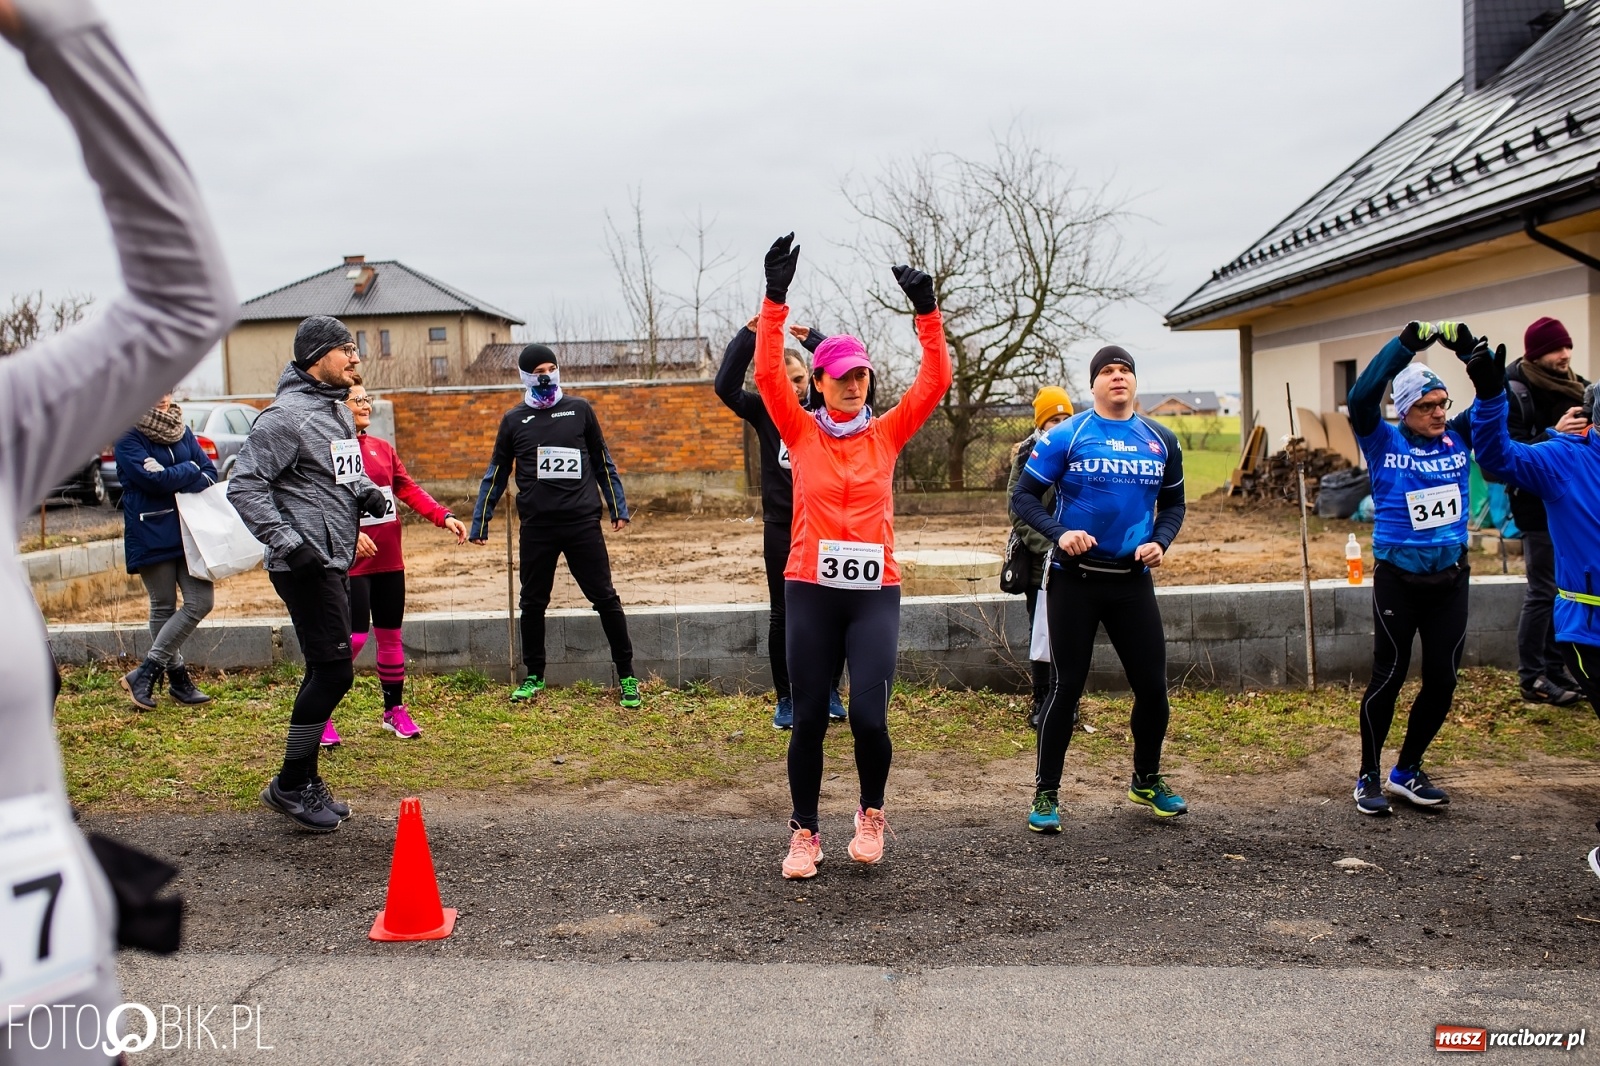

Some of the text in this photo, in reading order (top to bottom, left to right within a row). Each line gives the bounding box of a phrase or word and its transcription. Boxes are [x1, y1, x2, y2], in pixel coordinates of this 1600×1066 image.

[336, 454, 361, 475] 218
[540, 458, 578, 472] 422
[1069, 458, 1166, 476] RUNNER
[1413, 499, 1457, 521] 341
[821, 558, 880, 581] 360
[0, 872, 63, 977] 7
